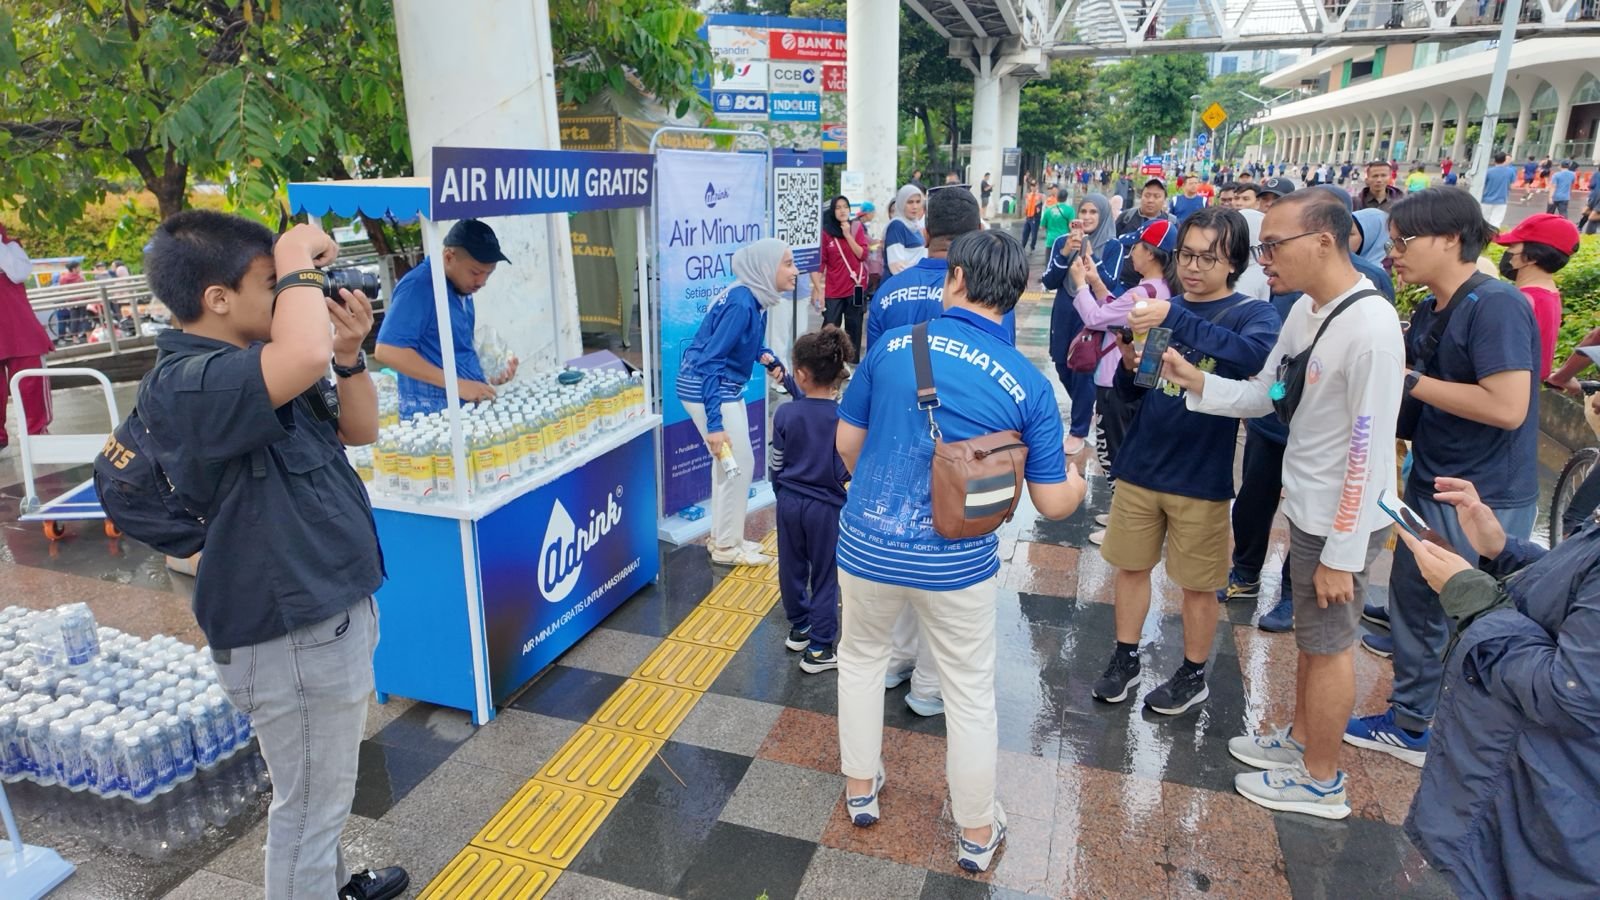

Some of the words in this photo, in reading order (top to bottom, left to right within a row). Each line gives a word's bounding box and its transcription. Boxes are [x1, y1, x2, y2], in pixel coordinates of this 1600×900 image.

[797, 36, 832, 50] BANK
[774, 69, 802, 81] CCB
[733, 94, 765, 110] BCA
[440, 167, 487, 203] AIR
[494, 167, 579, 200] MINUM
[584, 167, 648, 197] GRATIS
[571, 232, 588, 243] ta
[669, 218, 697, 248] Air
[702, 218, 760, 244] Minum
[572, 245, 616, 257] KARTA
[685, 286, 712, 300] Setiap
[886, 334, 1027, 405] #FEEWATER
[1333, 415, 1372, 533] MANDALORIAN
[868, 534, 884, 545] FREE
[887, 540, 910, 549] WATER
[522, 638, 536, 656] AIR
[535, 619, 560, 646] MINUM
[560, 601, 584, 626] GRATIS
[584, 588, 605, 608] UNTUK
[604, 557, 641, 592] MASYARAKAT
